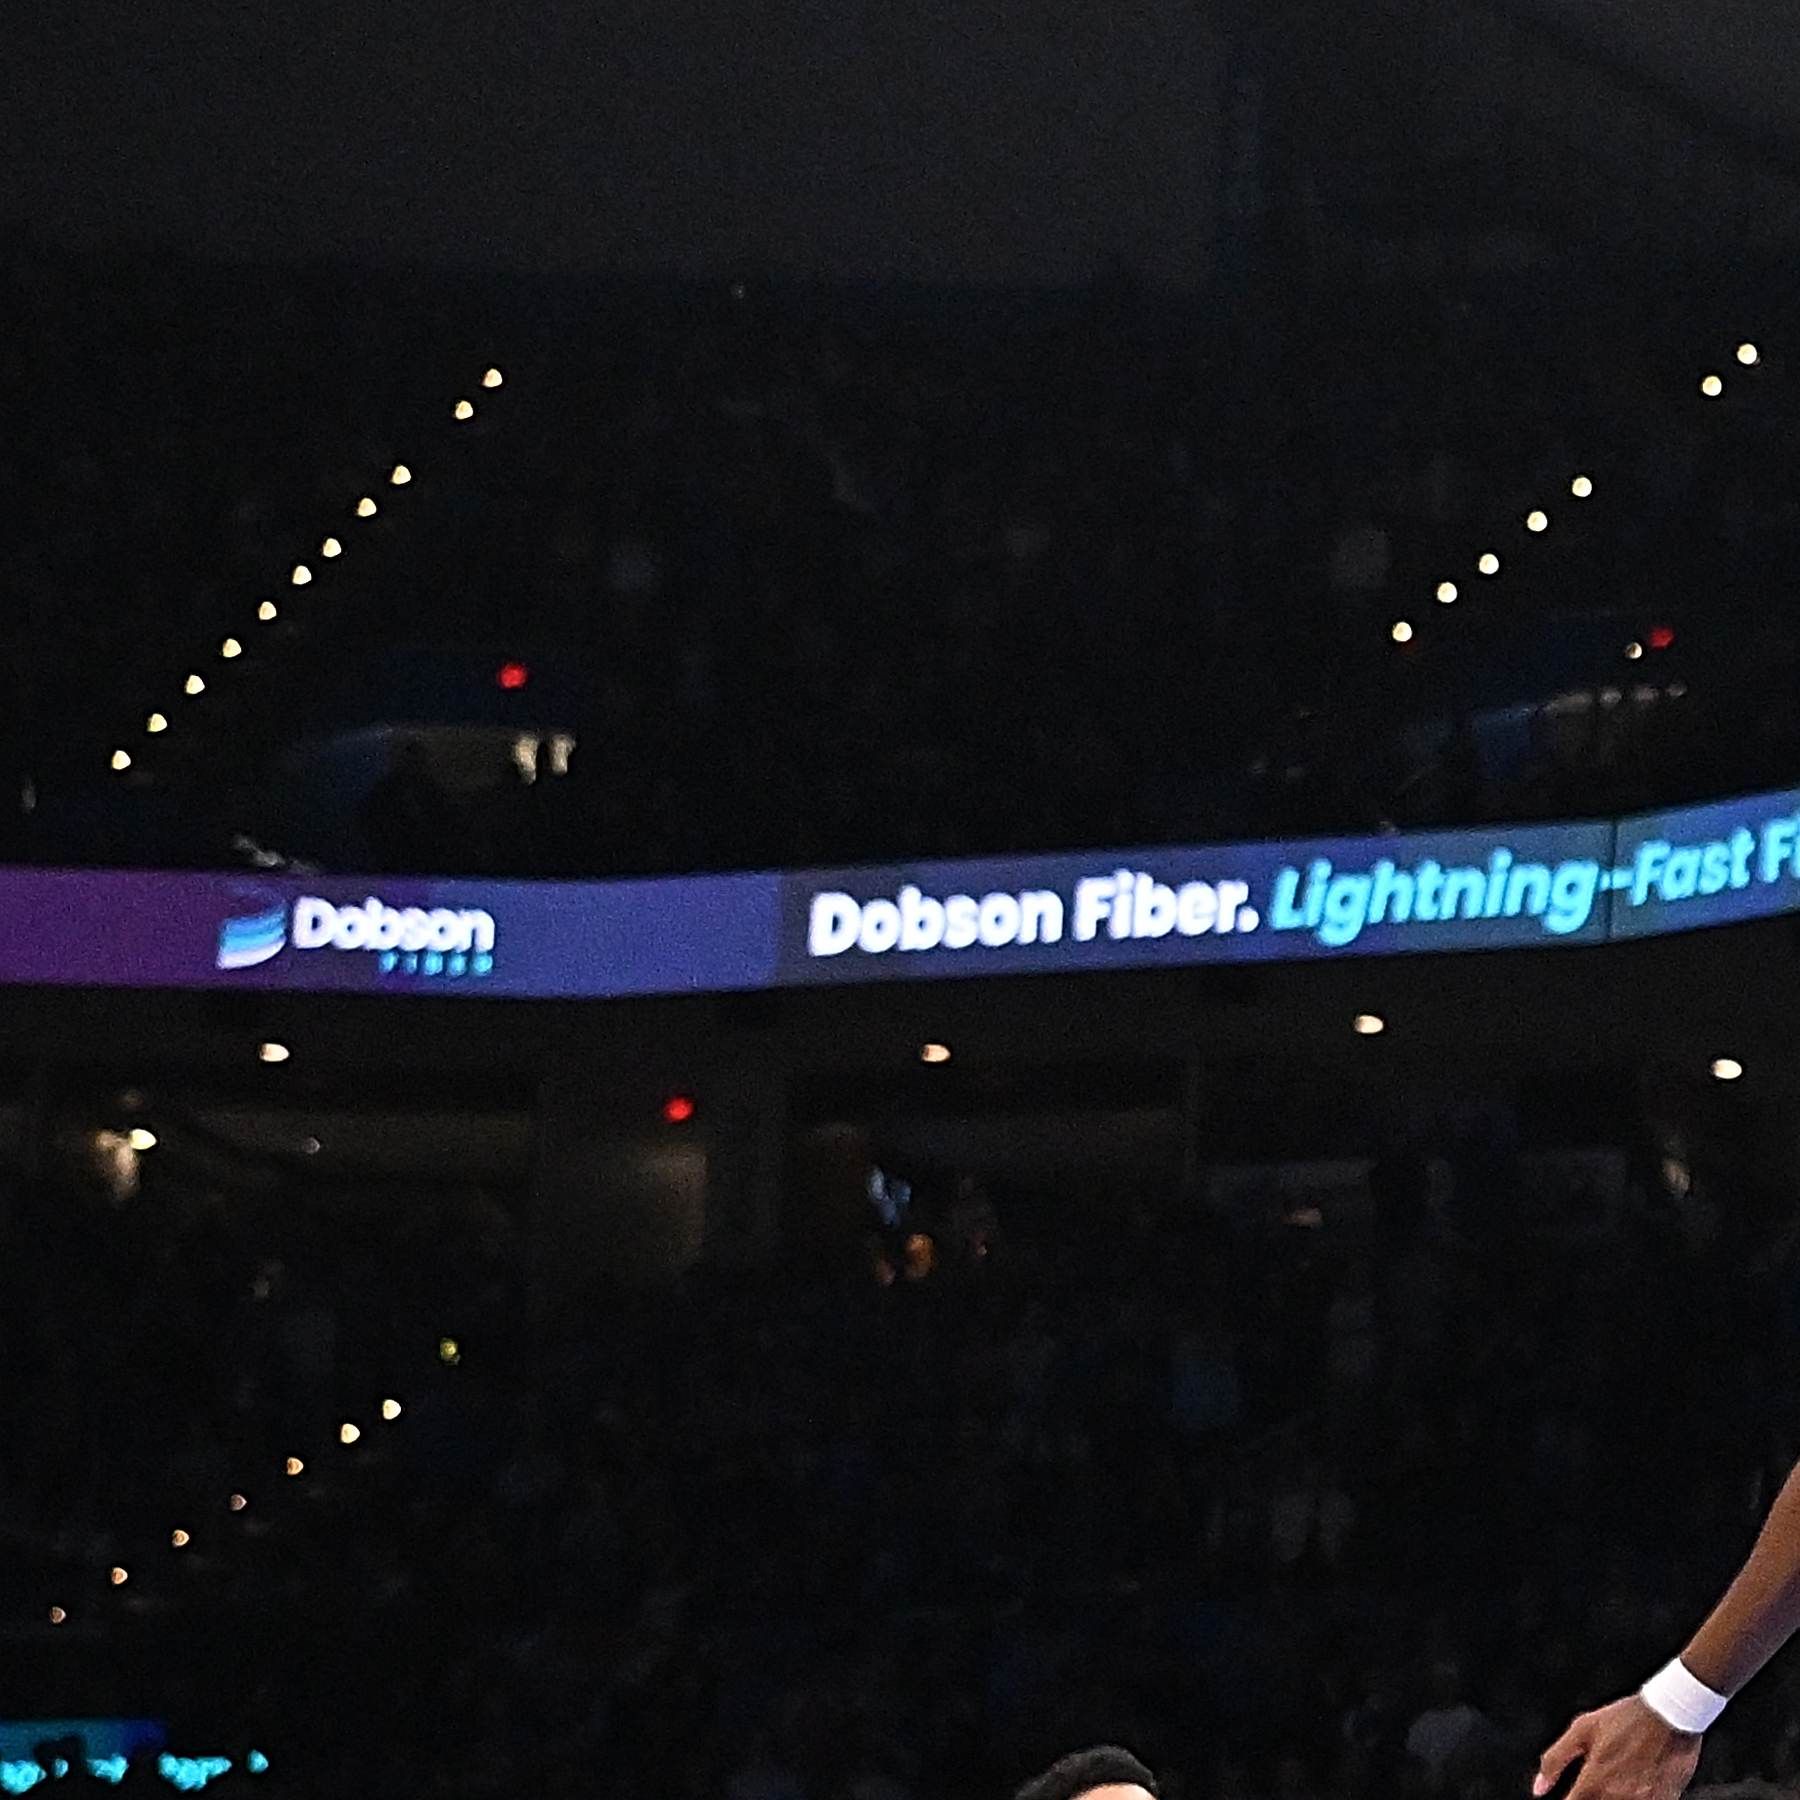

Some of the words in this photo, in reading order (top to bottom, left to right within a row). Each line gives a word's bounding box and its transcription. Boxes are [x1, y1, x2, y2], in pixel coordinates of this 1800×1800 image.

[292, 895, 495, 951] Dobson
[808, 885, 1064, 957] Dobson
[1072, 868, 1261, 943] Fiber.
[1268, 826, 1757, 946] Lightning-Fast
